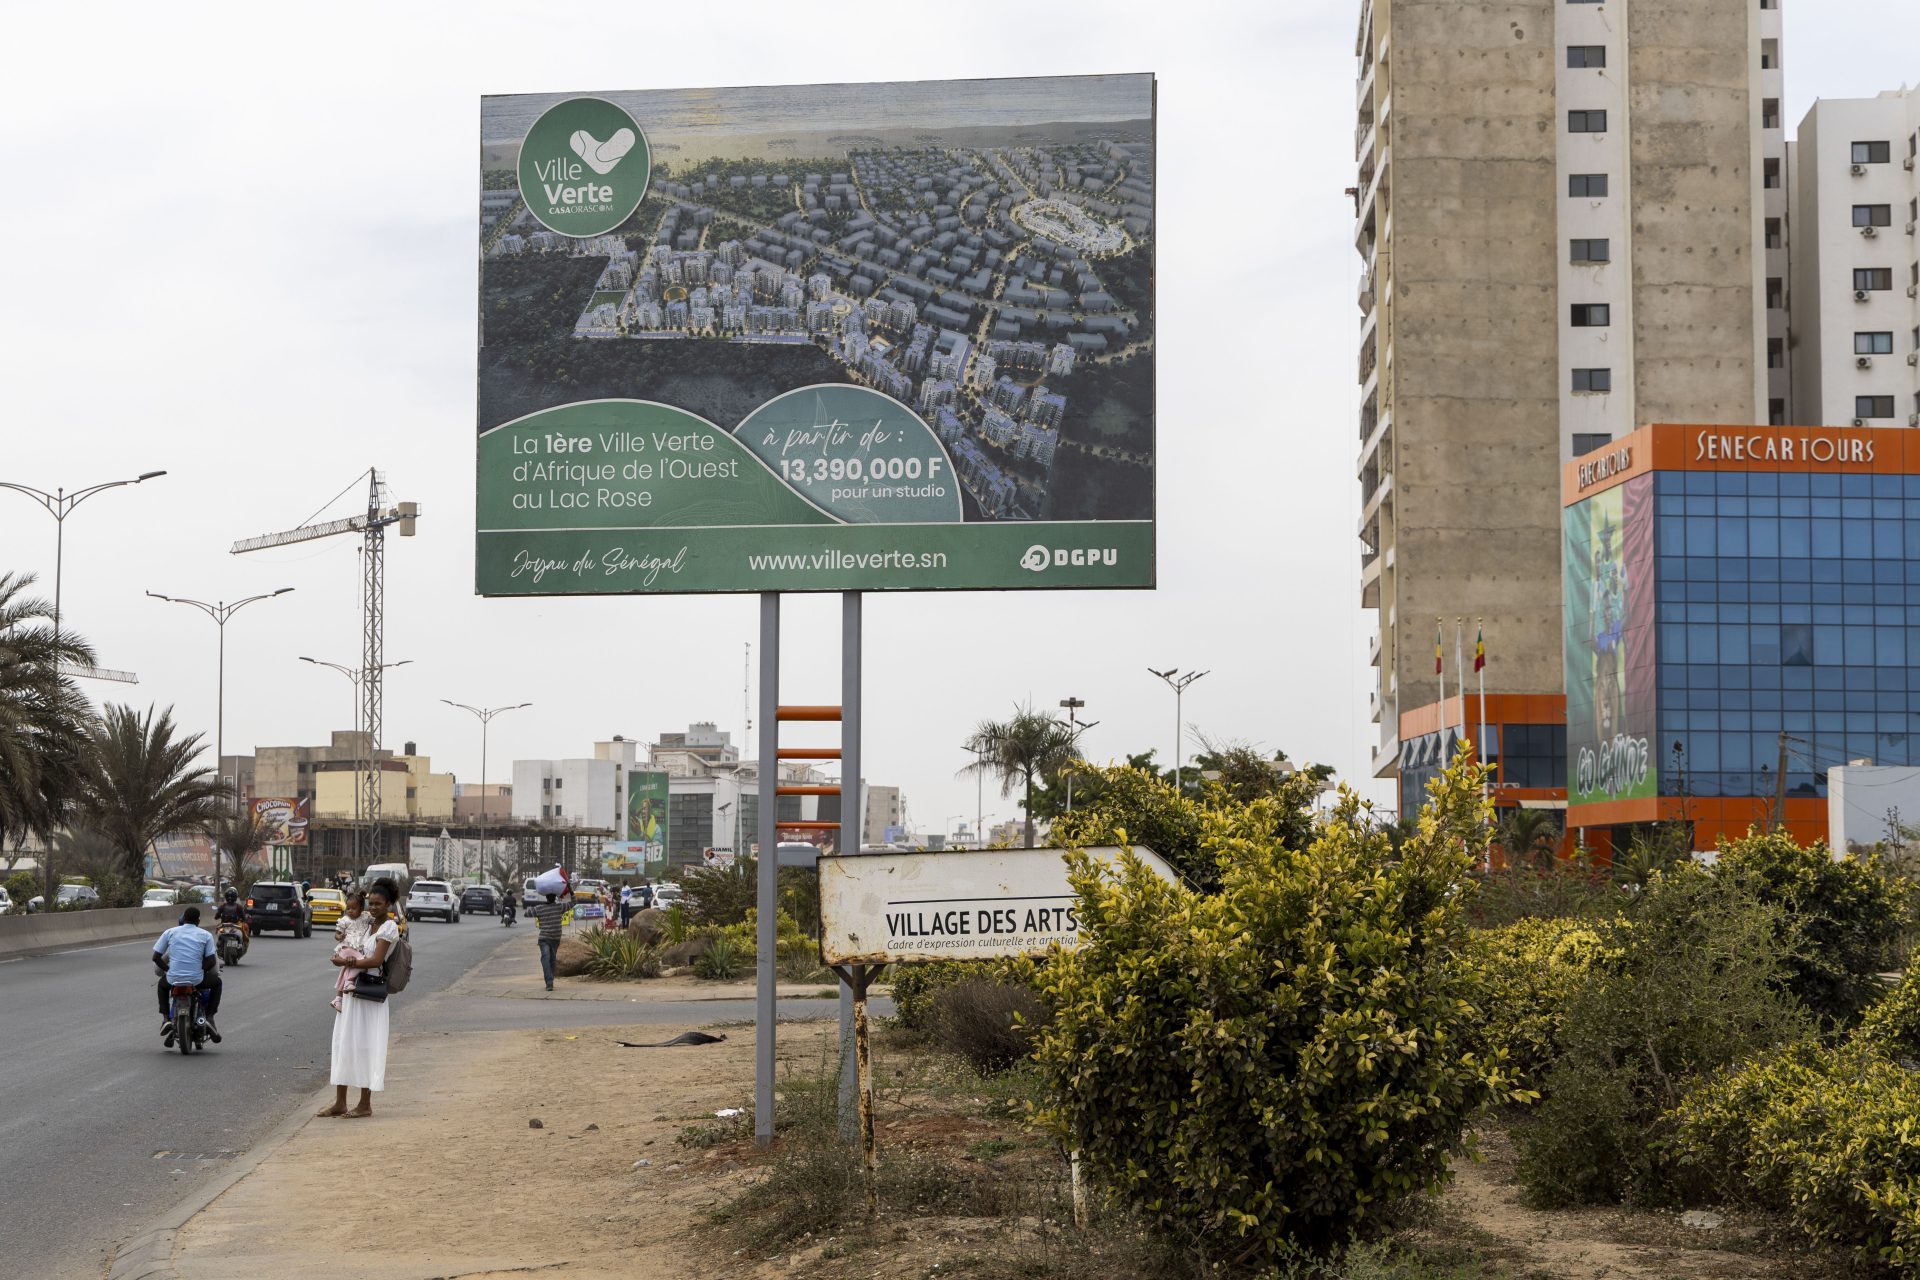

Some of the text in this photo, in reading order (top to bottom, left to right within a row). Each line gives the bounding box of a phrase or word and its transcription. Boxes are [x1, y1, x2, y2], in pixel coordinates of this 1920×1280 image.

[534, 157, 582, 182] Ville
[543, 182, 614, 205] Verte
[513, 431, 715, 454] La 1ère Ville Verte
[762, 427, 780, 446] à
[782, 419, 853, 456] partir
[860, 419, 892, 451] de
[512, 458, 739, 486] d'Afrique de l'Ouest
[780, 457, 943, 485] 13,390,000 F
[512, 488, 652, 509] au Lac Rose
[832, 483, 946, 502] pour un studio
[511, 546, 688, 587] Joyau du Sénégal
[748, 549, 948, 571] www.villeverte.sn
[1054, 548, 1118, 566] DGPU
[886, 907, 1078, 937] VILLAGE DES ARTS
[887, 938, 914, 950] Cadre
[916, 938, 975, 951] d'expression
[978, 936, 1024, 948] culturelle
[1026, 937, 1037, 946] et
